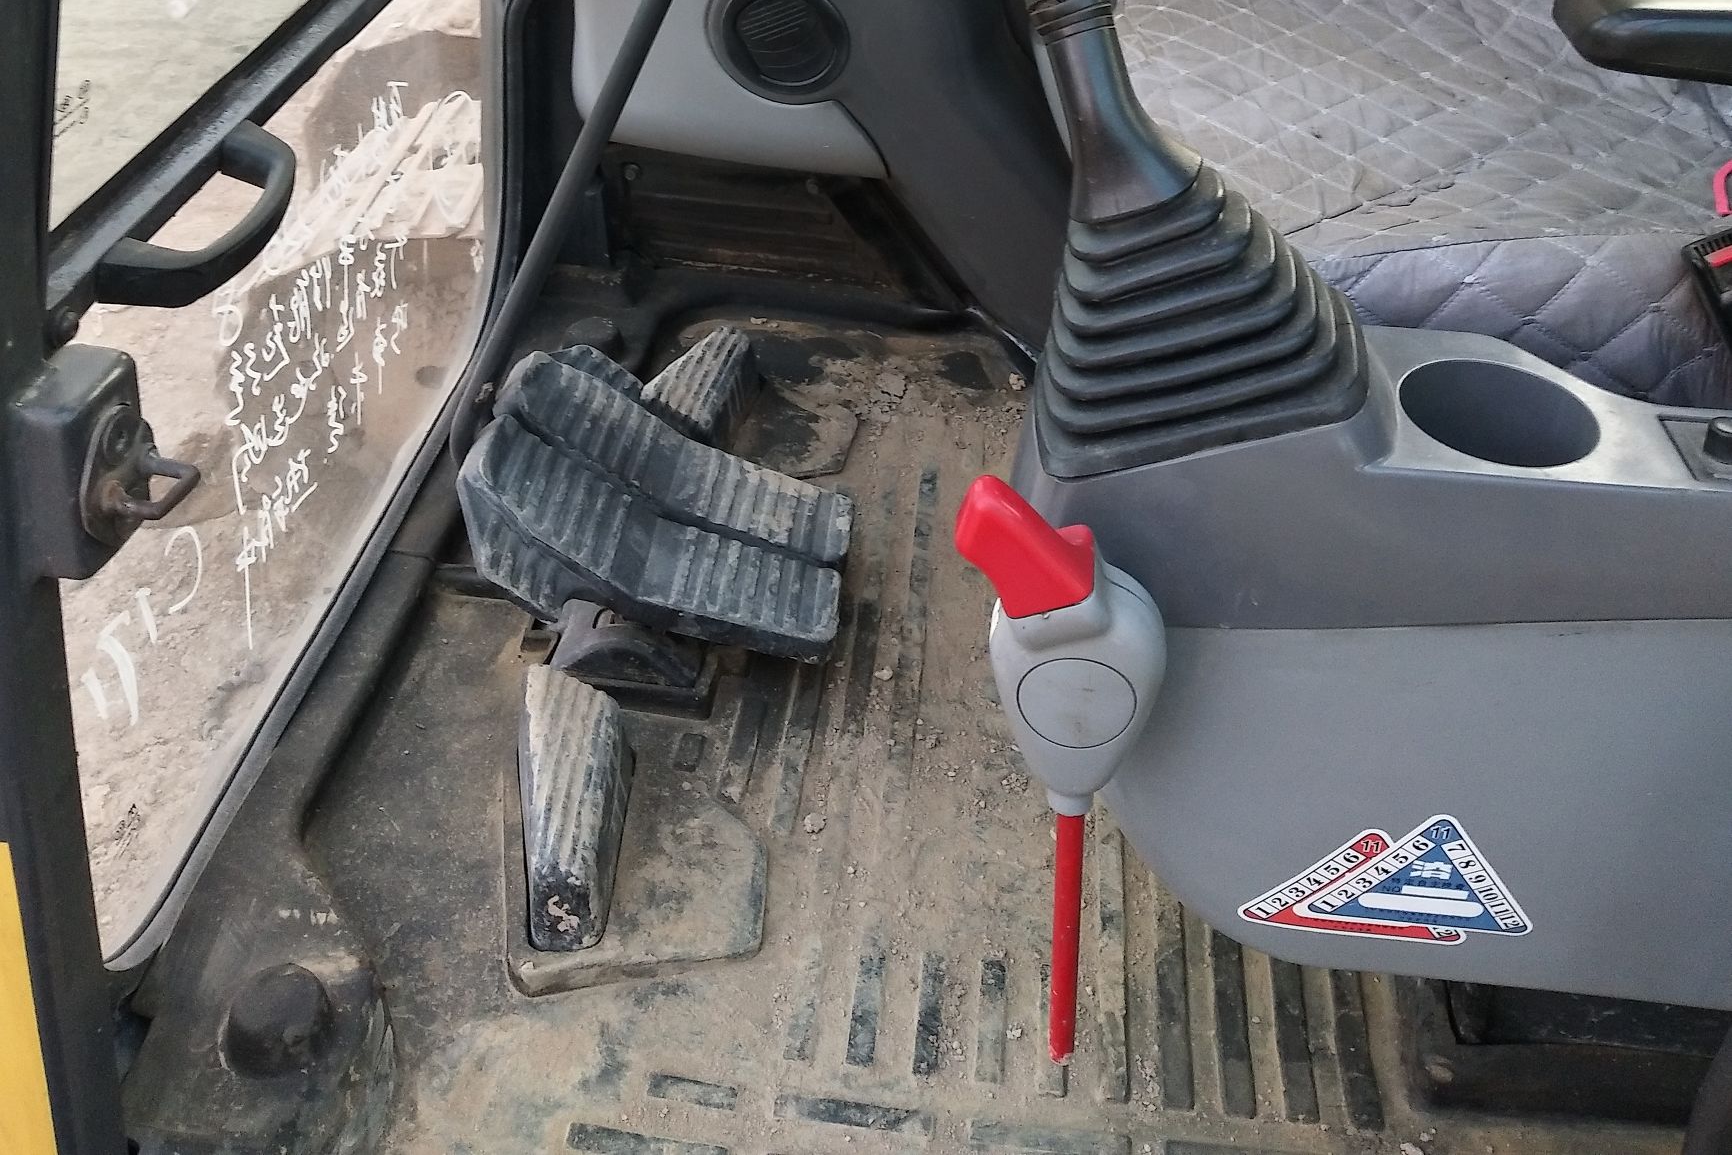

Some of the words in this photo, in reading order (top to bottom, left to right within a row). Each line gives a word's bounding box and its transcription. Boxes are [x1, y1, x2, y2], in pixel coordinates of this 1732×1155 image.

[1431, 825, 1452, 840] 11
[1360, 839, 1382, 854] 11
[1271, 897, 1289, 908] 2
[1288, 887, 1306, 898] 3
[1306, 877, 1324, 888] 4
[1324, 864, 1340, 876] 5
[1343, 852, 1360, 864] 6
[1337, 889, 1355, 900] 2
[1355, 877, 1373, 889] 3
[1374, 865, 1392, 876] 4
[1392, 853, 1409, 864] 5
[1412, 839, 1429, 851] 6
[1458, 859, 1477, 869] 8
[1469, 875, 1487, 884] 9
